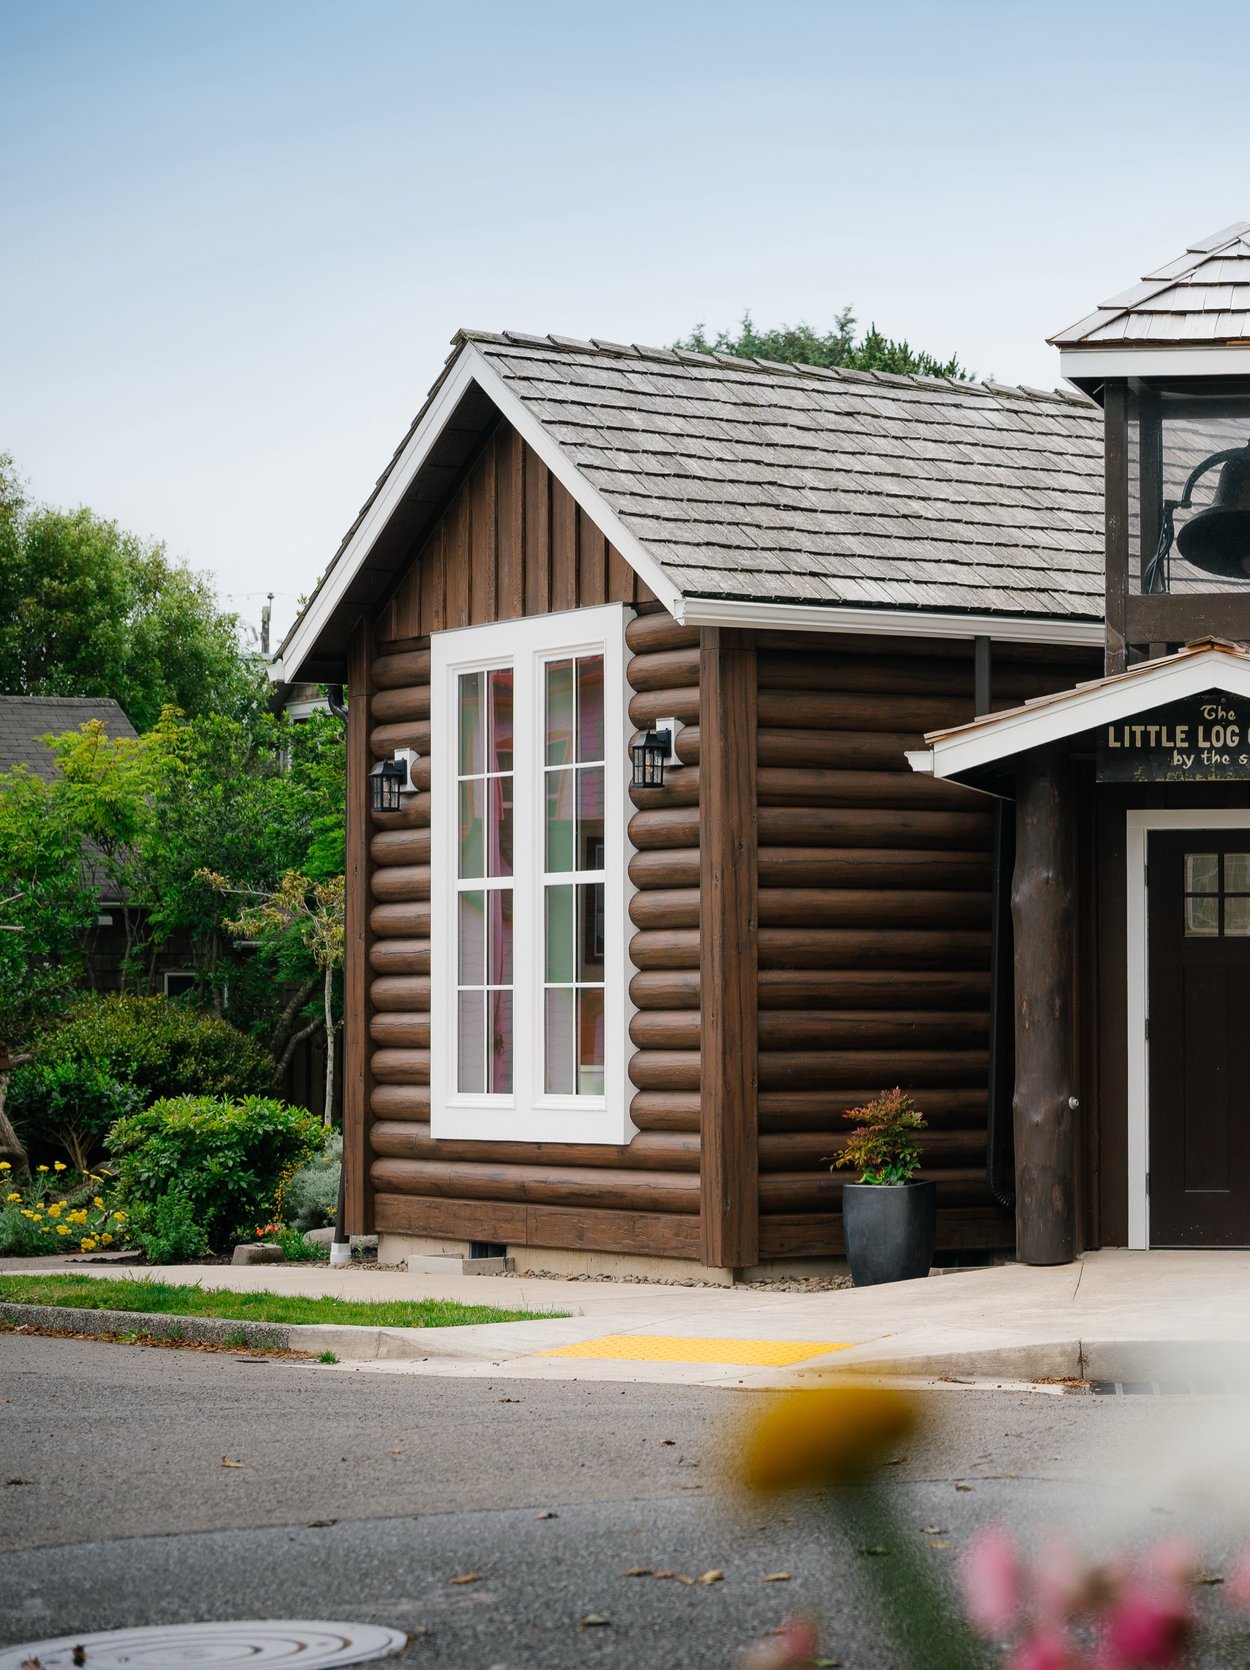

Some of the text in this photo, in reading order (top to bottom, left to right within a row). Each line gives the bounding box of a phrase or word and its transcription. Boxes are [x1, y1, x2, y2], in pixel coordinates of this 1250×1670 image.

[1200, 704, 1237, 721] The
[1108, 725, 1189, 748] LITTLE
[1197, 725, 1240, 748] LOG
[1173, 749, 1194, 769] by
[1201, 749, 1230, 765] the
